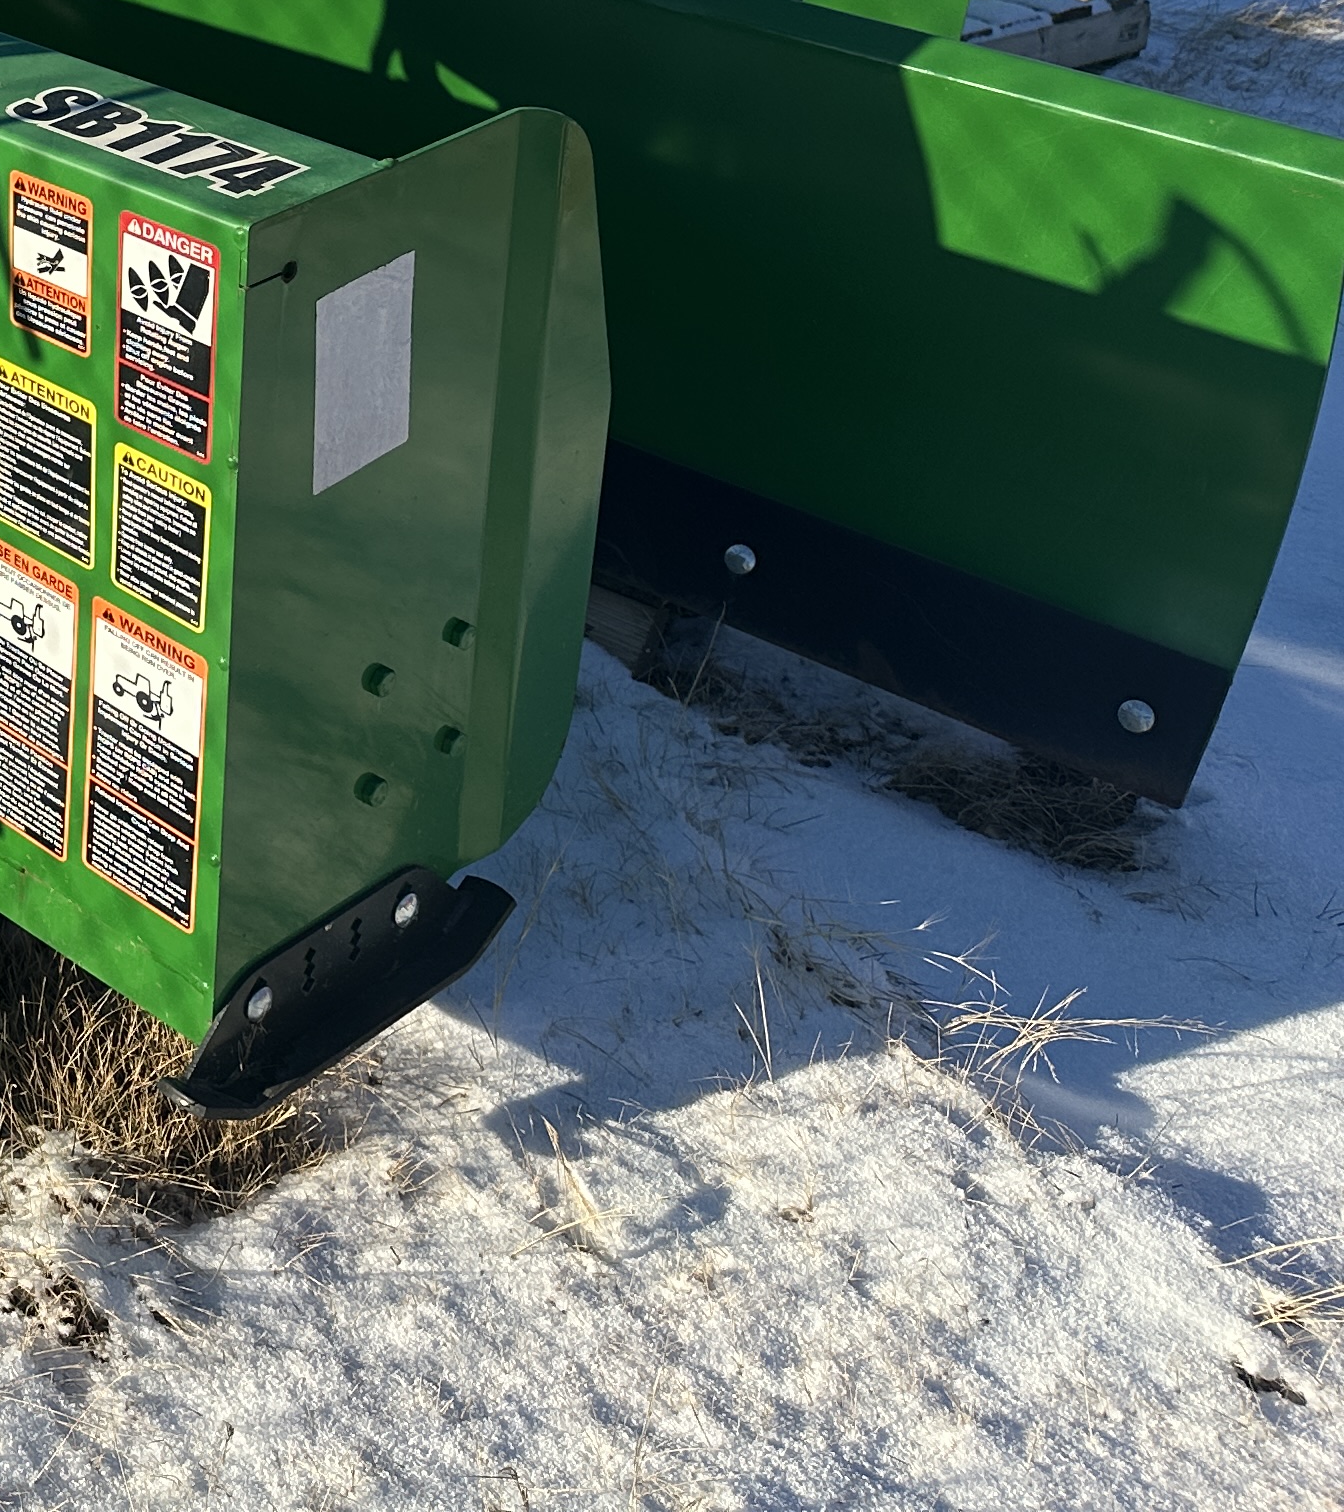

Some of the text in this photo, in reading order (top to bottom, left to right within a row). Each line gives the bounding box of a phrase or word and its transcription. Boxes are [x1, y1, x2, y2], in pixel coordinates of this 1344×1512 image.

[12, 87, 300, 194] SB1174
[27, 180, 87, 216] WARNING
[141, 222, 214, 265] DANGER
[26, 275, 85, 313] ATTENTION
[10, 371, 90, 419] ATTENTION
[136, 457, 206, 503] CAUTION
[14, 554, 30, 573] EN
[32, 565, 73, 599] GARDE
[118, 614, 196, 670] WARNING
